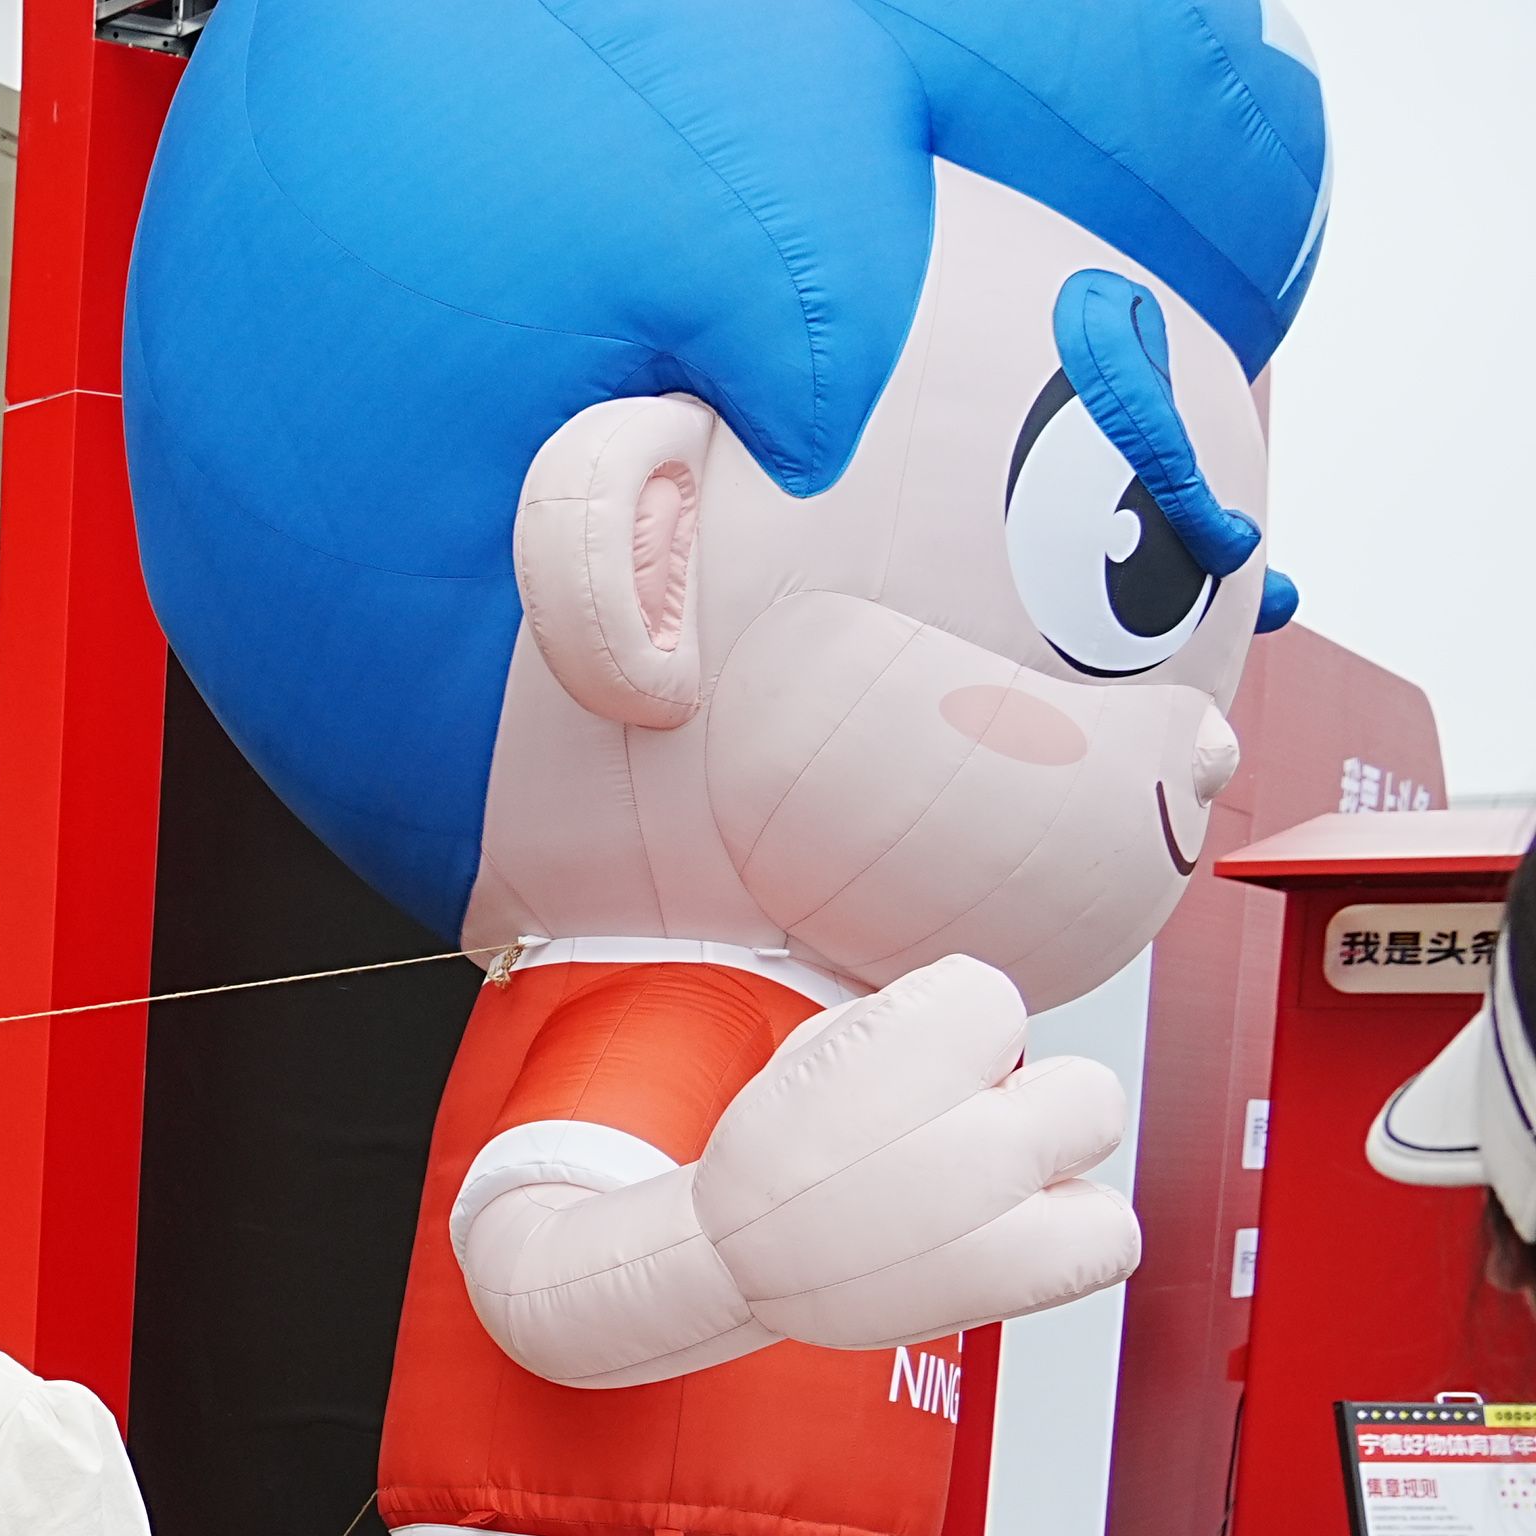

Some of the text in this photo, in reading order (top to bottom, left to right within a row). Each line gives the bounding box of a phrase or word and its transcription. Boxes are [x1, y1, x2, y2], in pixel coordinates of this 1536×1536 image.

[1357, 1432, 1536, 1458] 宁德好物体育嘉年
